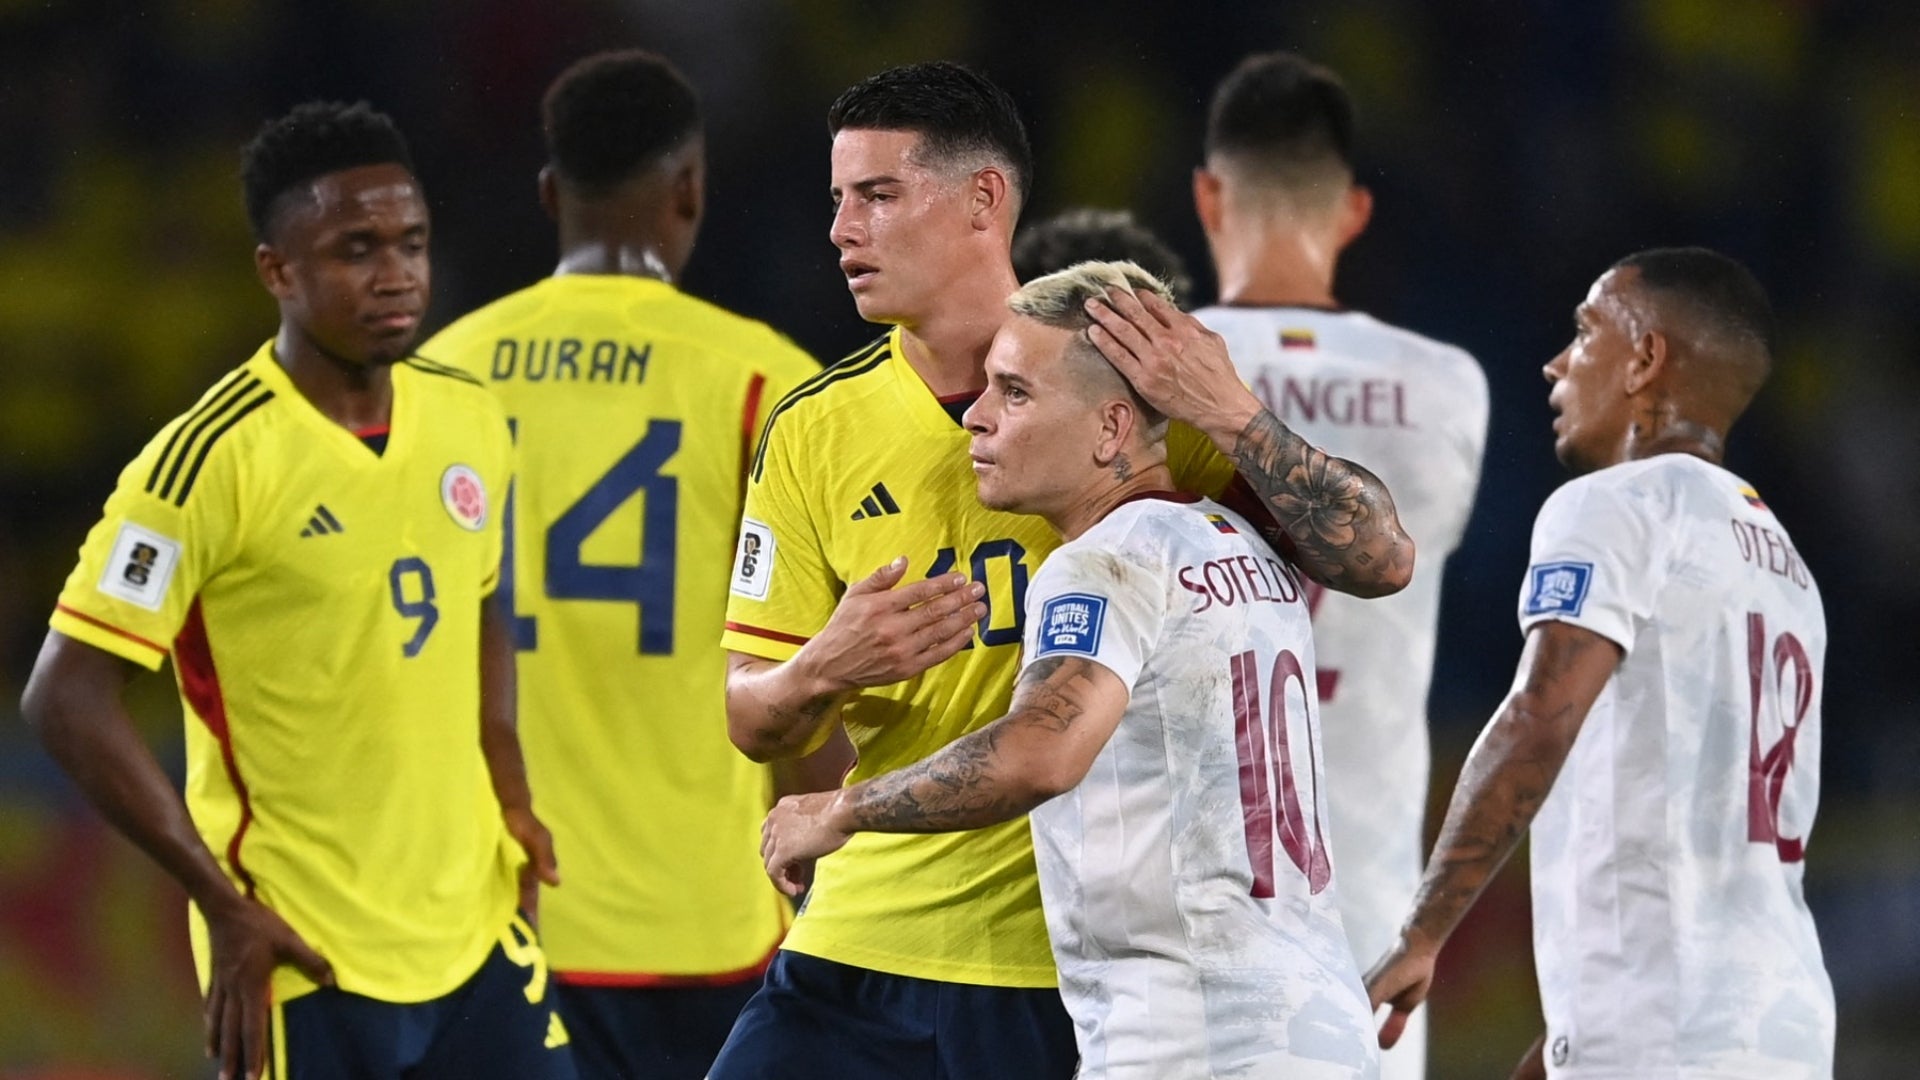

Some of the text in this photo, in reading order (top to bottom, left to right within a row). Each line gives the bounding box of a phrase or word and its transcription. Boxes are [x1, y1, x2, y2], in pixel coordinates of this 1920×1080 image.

[491, 339, 652, 384] DURAN
[389, 556, 439, 657] 9
[925, 538, 1028, 650] 0
[1051, 611, 1089, 627] UNITES
[1230, 649, 1331, 897] 10
[1746, 611, 1813, 863] 18
